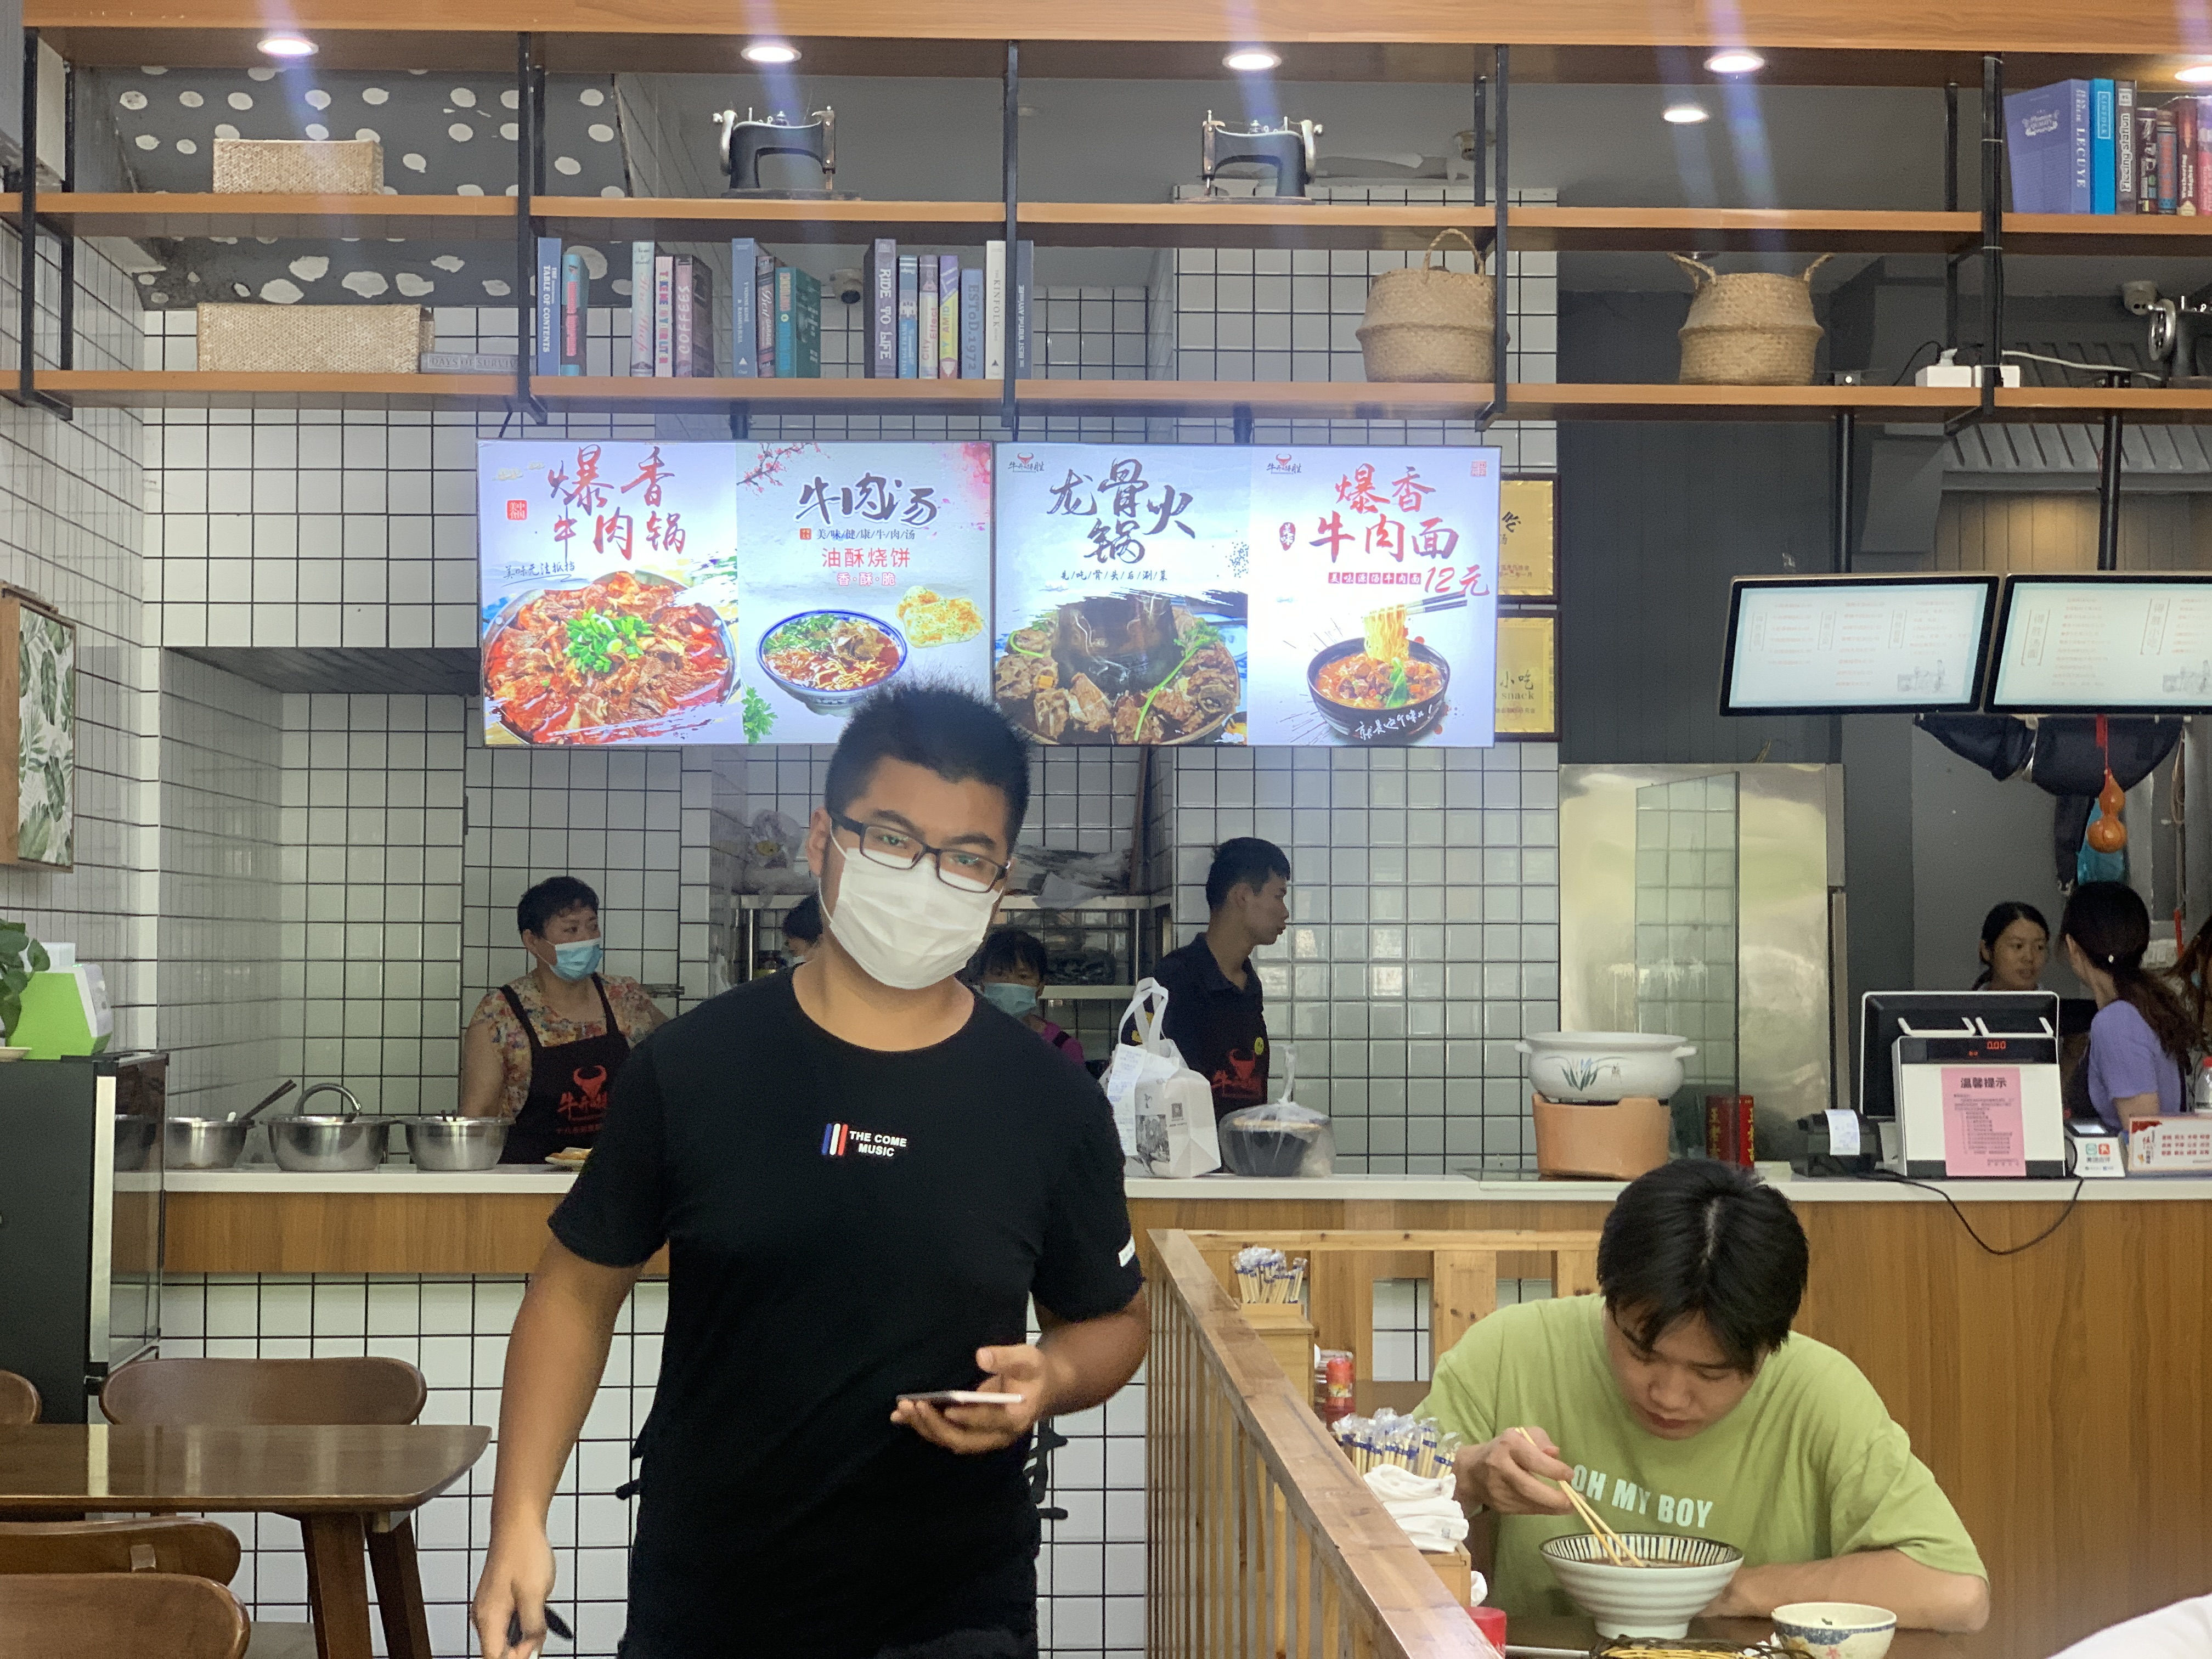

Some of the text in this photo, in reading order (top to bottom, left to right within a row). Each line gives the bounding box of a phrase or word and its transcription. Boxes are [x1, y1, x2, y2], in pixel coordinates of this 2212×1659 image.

[542, 265, 551, 353] TABLE OF CONTENTS
[678, 286, 690, 355] COFFEES
[761, 290, 772, 318] Best
[879, 268, 893, 360] RIDE TO LIFE
[432, 357, 458, 366] DAYS
[921, 338, 931, 360] City
[548, 444, 675, 516] 爆香
[795, 472, 938, 526] 牛肉汤
[1335, 463, 1436, 514] 爆香
[554, 505, 686, 563] 牛肉锅
[1309, 510, 1460, 563] 牛肉面
[822, 547, 911, 568] 油酥烧饼
[1499, 669, 1534, 690] 小吃
[1502, 690, 1535, 700] snack
[1960, 1077, 2008, 1089] 温馨提示
[849, 1131, 907, 1147] THE COME
[858, 1143, 895, 1157] MUSIC
[1571, 1464, 1713, 1528] OH MY BOY
